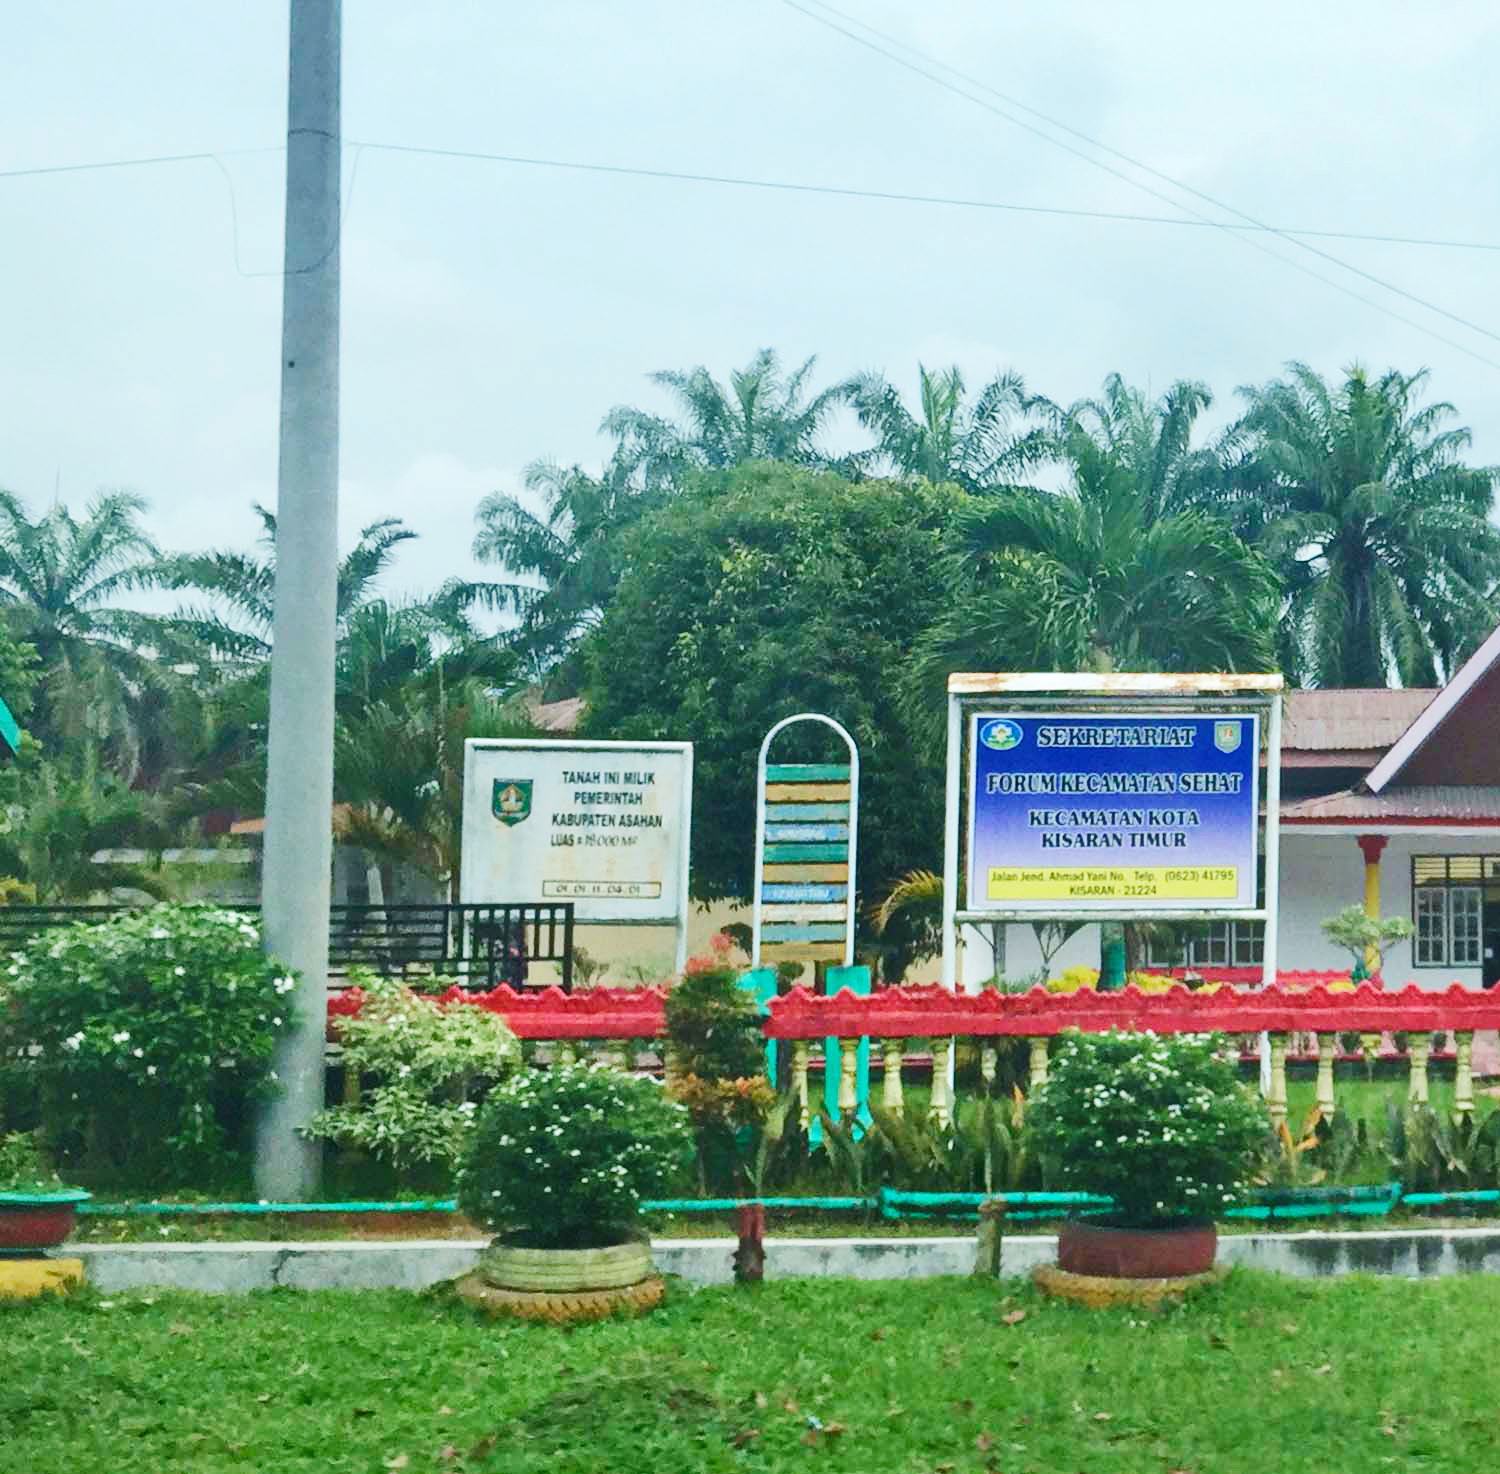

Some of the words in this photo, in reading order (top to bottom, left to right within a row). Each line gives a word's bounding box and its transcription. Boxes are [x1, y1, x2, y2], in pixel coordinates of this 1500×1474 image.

[1037, 726, 1196, 748] SEKRETARIAT
[562, 771, 600, 785] TANAH
[604, 772, 620, 785] INI
[623, 772, 656, 785] MILIK
[986, 772, 1055, 793] FORUM
[1060, 773, 1175, 794] KECAMATAN
[1179, 773, 1243, 794] SEHAT
[574, 791, 643, 805] PEMERINTAH
[551, 813, 616, 827] KABUPATEN
[618, 814, 663, 828] ASAHAN
[1029, 809, 1144, 827] KECAMATAN
[1148, 809, 1200, 826] KOTA
[550, 834, 575, 847] LUAS
[1041, 832, 1123, 849] KISARAN
[1130, 832, 1187, 848] TIMUR
[991, 872, 1018, 882] Jalan
[1049, 872, 1084, 881] Ahmad
[1087, 872, 1107, 881] Yani
[1164, 870, 1200, 882] (0623)
[1201, 870, 1234, 881] 41795
[1069, 886, 1115, 896] KISARAN
[1123, 886, 1157, 896] 21224
